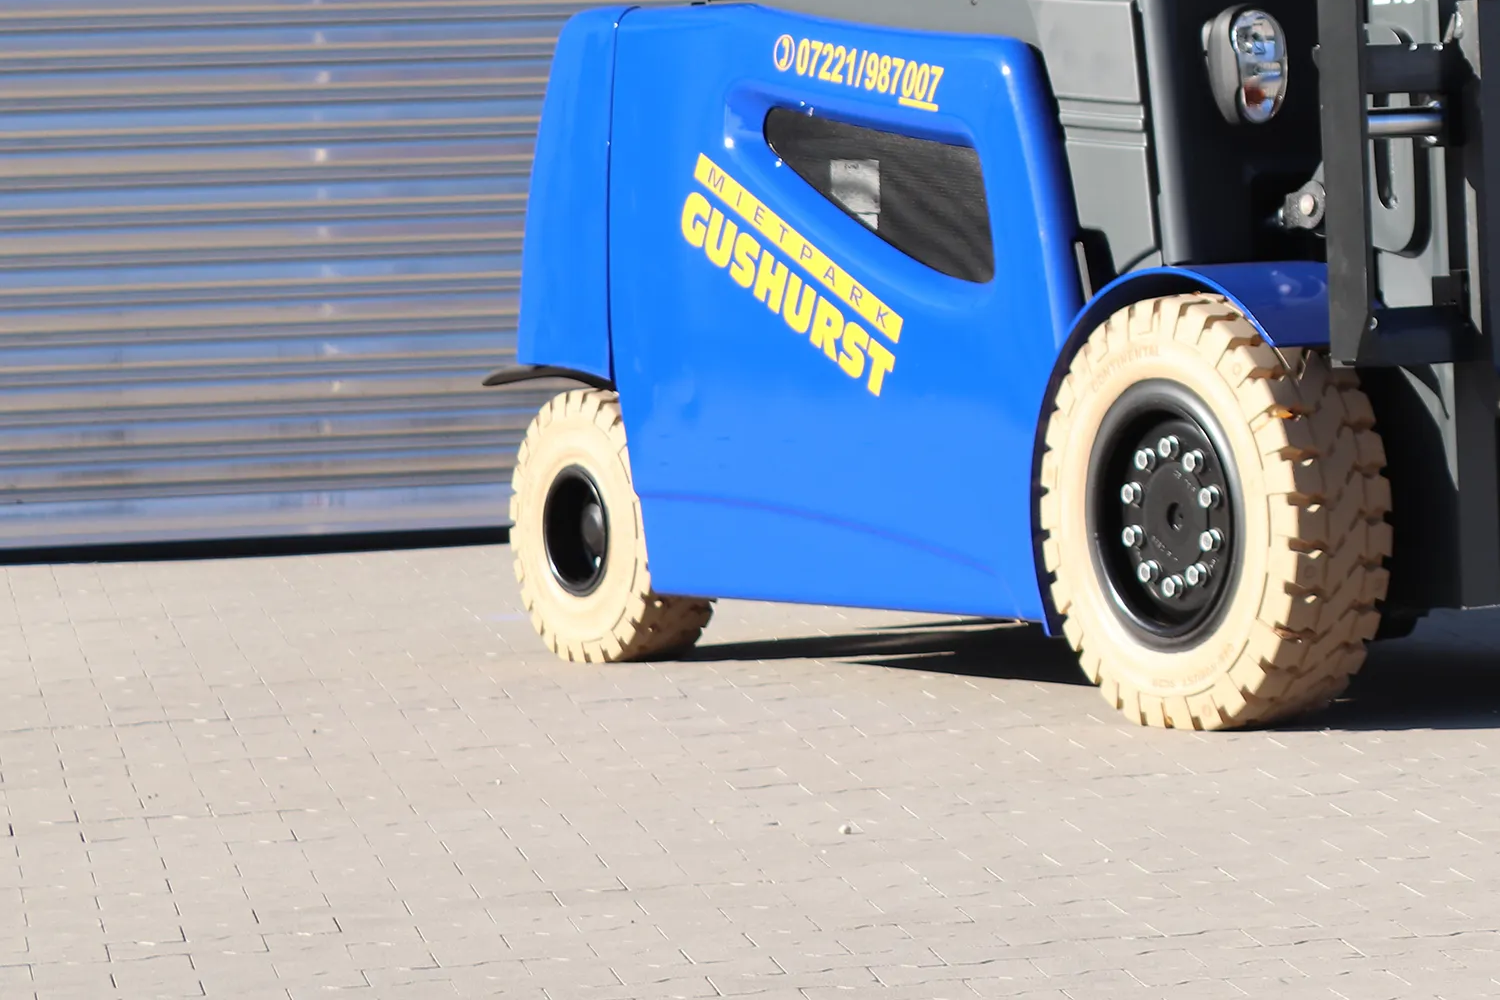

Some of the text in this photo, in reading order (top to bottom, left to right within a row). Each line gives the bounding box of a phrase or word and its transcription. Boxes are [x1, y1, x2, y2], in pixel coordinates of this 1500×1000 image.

[796, 38, 945, 104] 07221/987007
[681, 191, 897, 397] GUSHURST
[707, 166, 889, 329] MIETPARK
